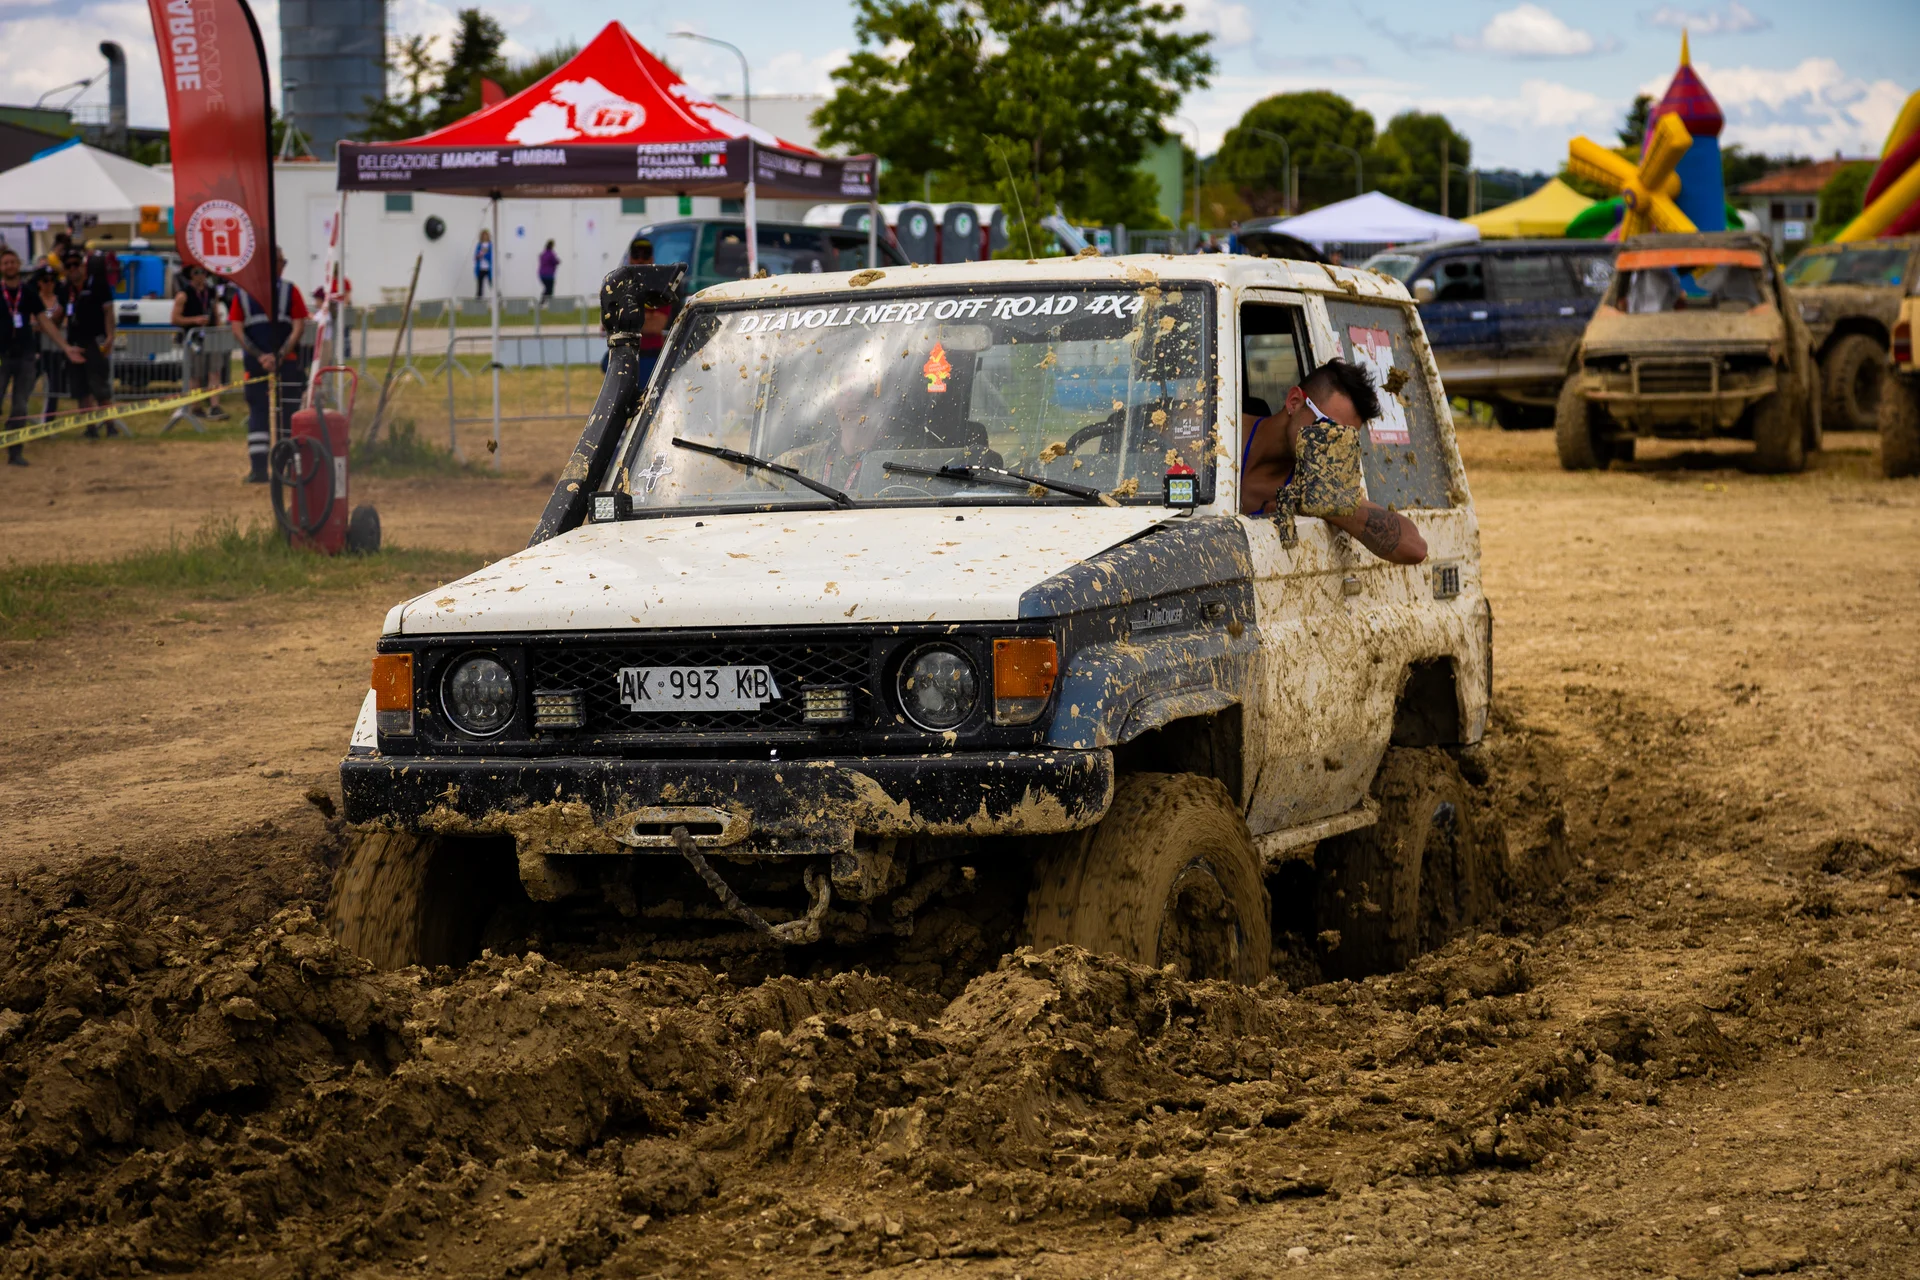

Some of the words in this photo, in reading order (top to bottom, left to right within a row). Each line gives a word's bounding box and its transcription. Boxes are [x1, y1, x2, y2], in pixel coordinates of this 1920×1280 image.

[637, 141, 727, 155] FEDERAZIONE
[357, 153, 440, 170] DELEGAZIONE
[441, 151, 498, 169] MARCHE
[512, 148, 567, 167] UMBRIA
[637, 155, 695, 167] ITALIANA
[637, 165, 727, 180] FUORISTRADA
[735, 306, 860, 334] DIAVOLI
[860, 298, 932, 324] NERI
[934, 297, 990, 320] OFF
[991, 295, 1078, 320] ROAD
[1083, 294, 1147, 319] 4X4
[621, 670, 651, 703] AK
[669, 669, 720, 699] 993
[735, 668, 769, 699] KB
